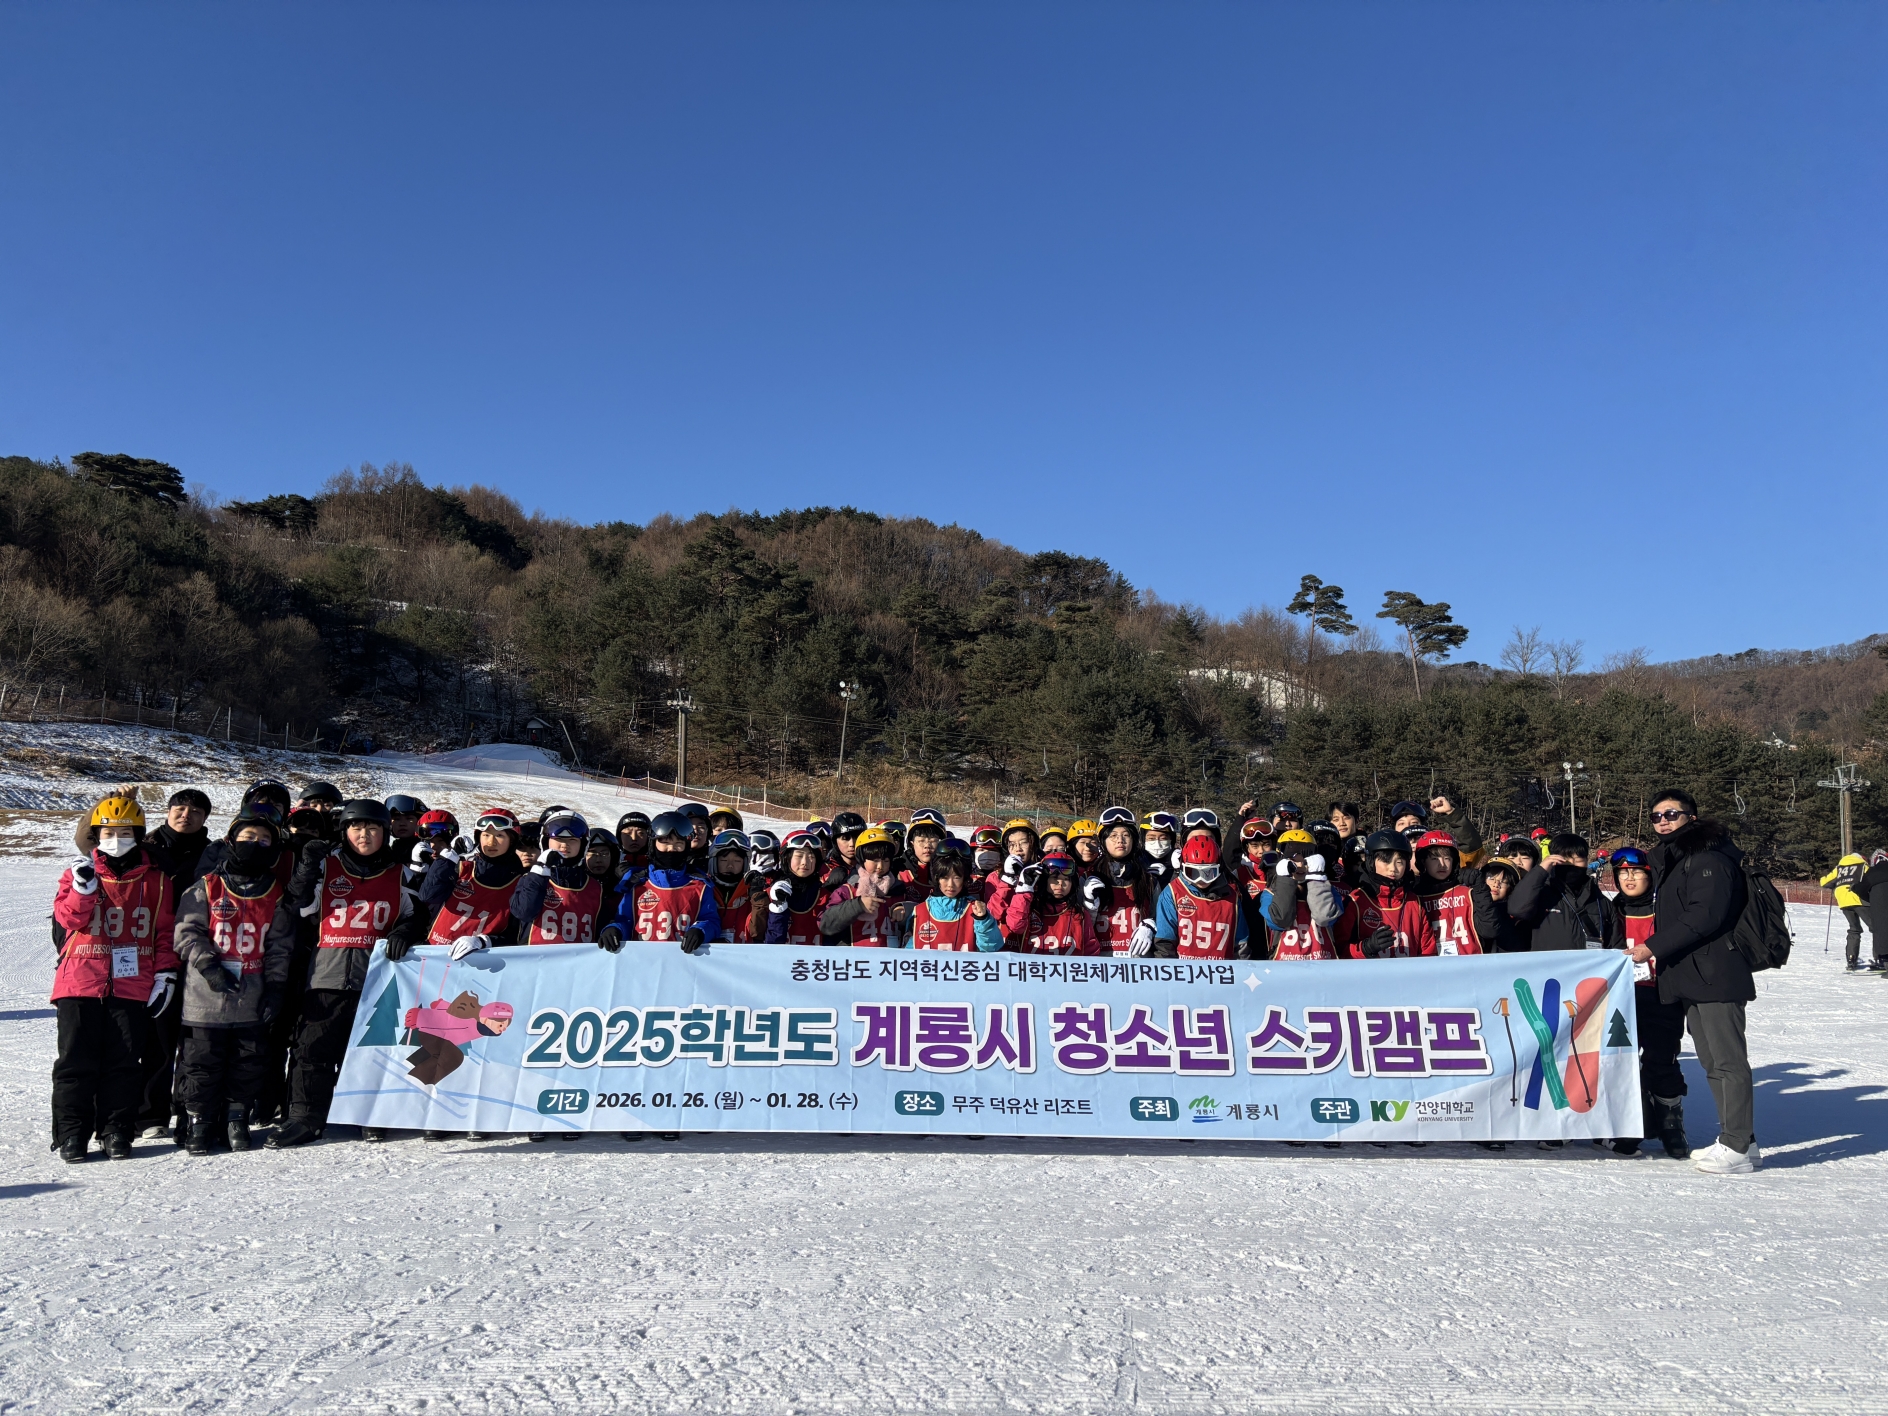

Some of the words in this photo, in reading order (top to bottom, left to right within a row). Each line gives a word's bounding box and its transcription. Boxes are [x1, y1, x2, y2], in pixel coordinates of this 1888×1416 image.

[1434, 895, 1466, 910] RESORT
[88, 905, 151, 939] 483
[329, 898, 391, 931] 320
[540, 909, 593, 943] 683
[1179, 918, 1230, 951] 357
[790, 959, 873, 982] 충청남도
[878, 959, 1001, 982] 지역혁신중심
[1007, 961, 1236, 985] 대학지원체계[RISE]사업
[525, 1006, 835, 1064] 2025학년도
[855, 1004, 1031, 1068] 계룡시
[1052, 1006, 1230, 1070] 청소년
[1250, 1010, 1489, 1073] 스키캠프
[546, 1092, 582, 1111] 기간
[596, 1092, 646, 1108] 2026.
[651, 1092, 676, 1108] 01.
[682, 1092, 709, 1108] 26.
[714, 1091, 744, 1110] (월)
[766, 1092, 791, 1108] 01.
[796, 1092, 824, 1108] 28.
[829, 1092, 859, 1110] (수)
[902, 1093, 937, 1112] 장소
[952, 1095, 985, 1114] 무주
[990, 1097, 1038, 1115] 덕유산
[1044, 1098, 1094, 1116] 리조트
[1138, 1099, 1171, 1118] 주최
[1318, 1100, 1351, 1120] 주관
[1415, 1101, 1475, 1115] 건양대학교
[1226, 1103, 1279, 1121] 계룡시
[1370, 1100, 1411, 1122] KY
